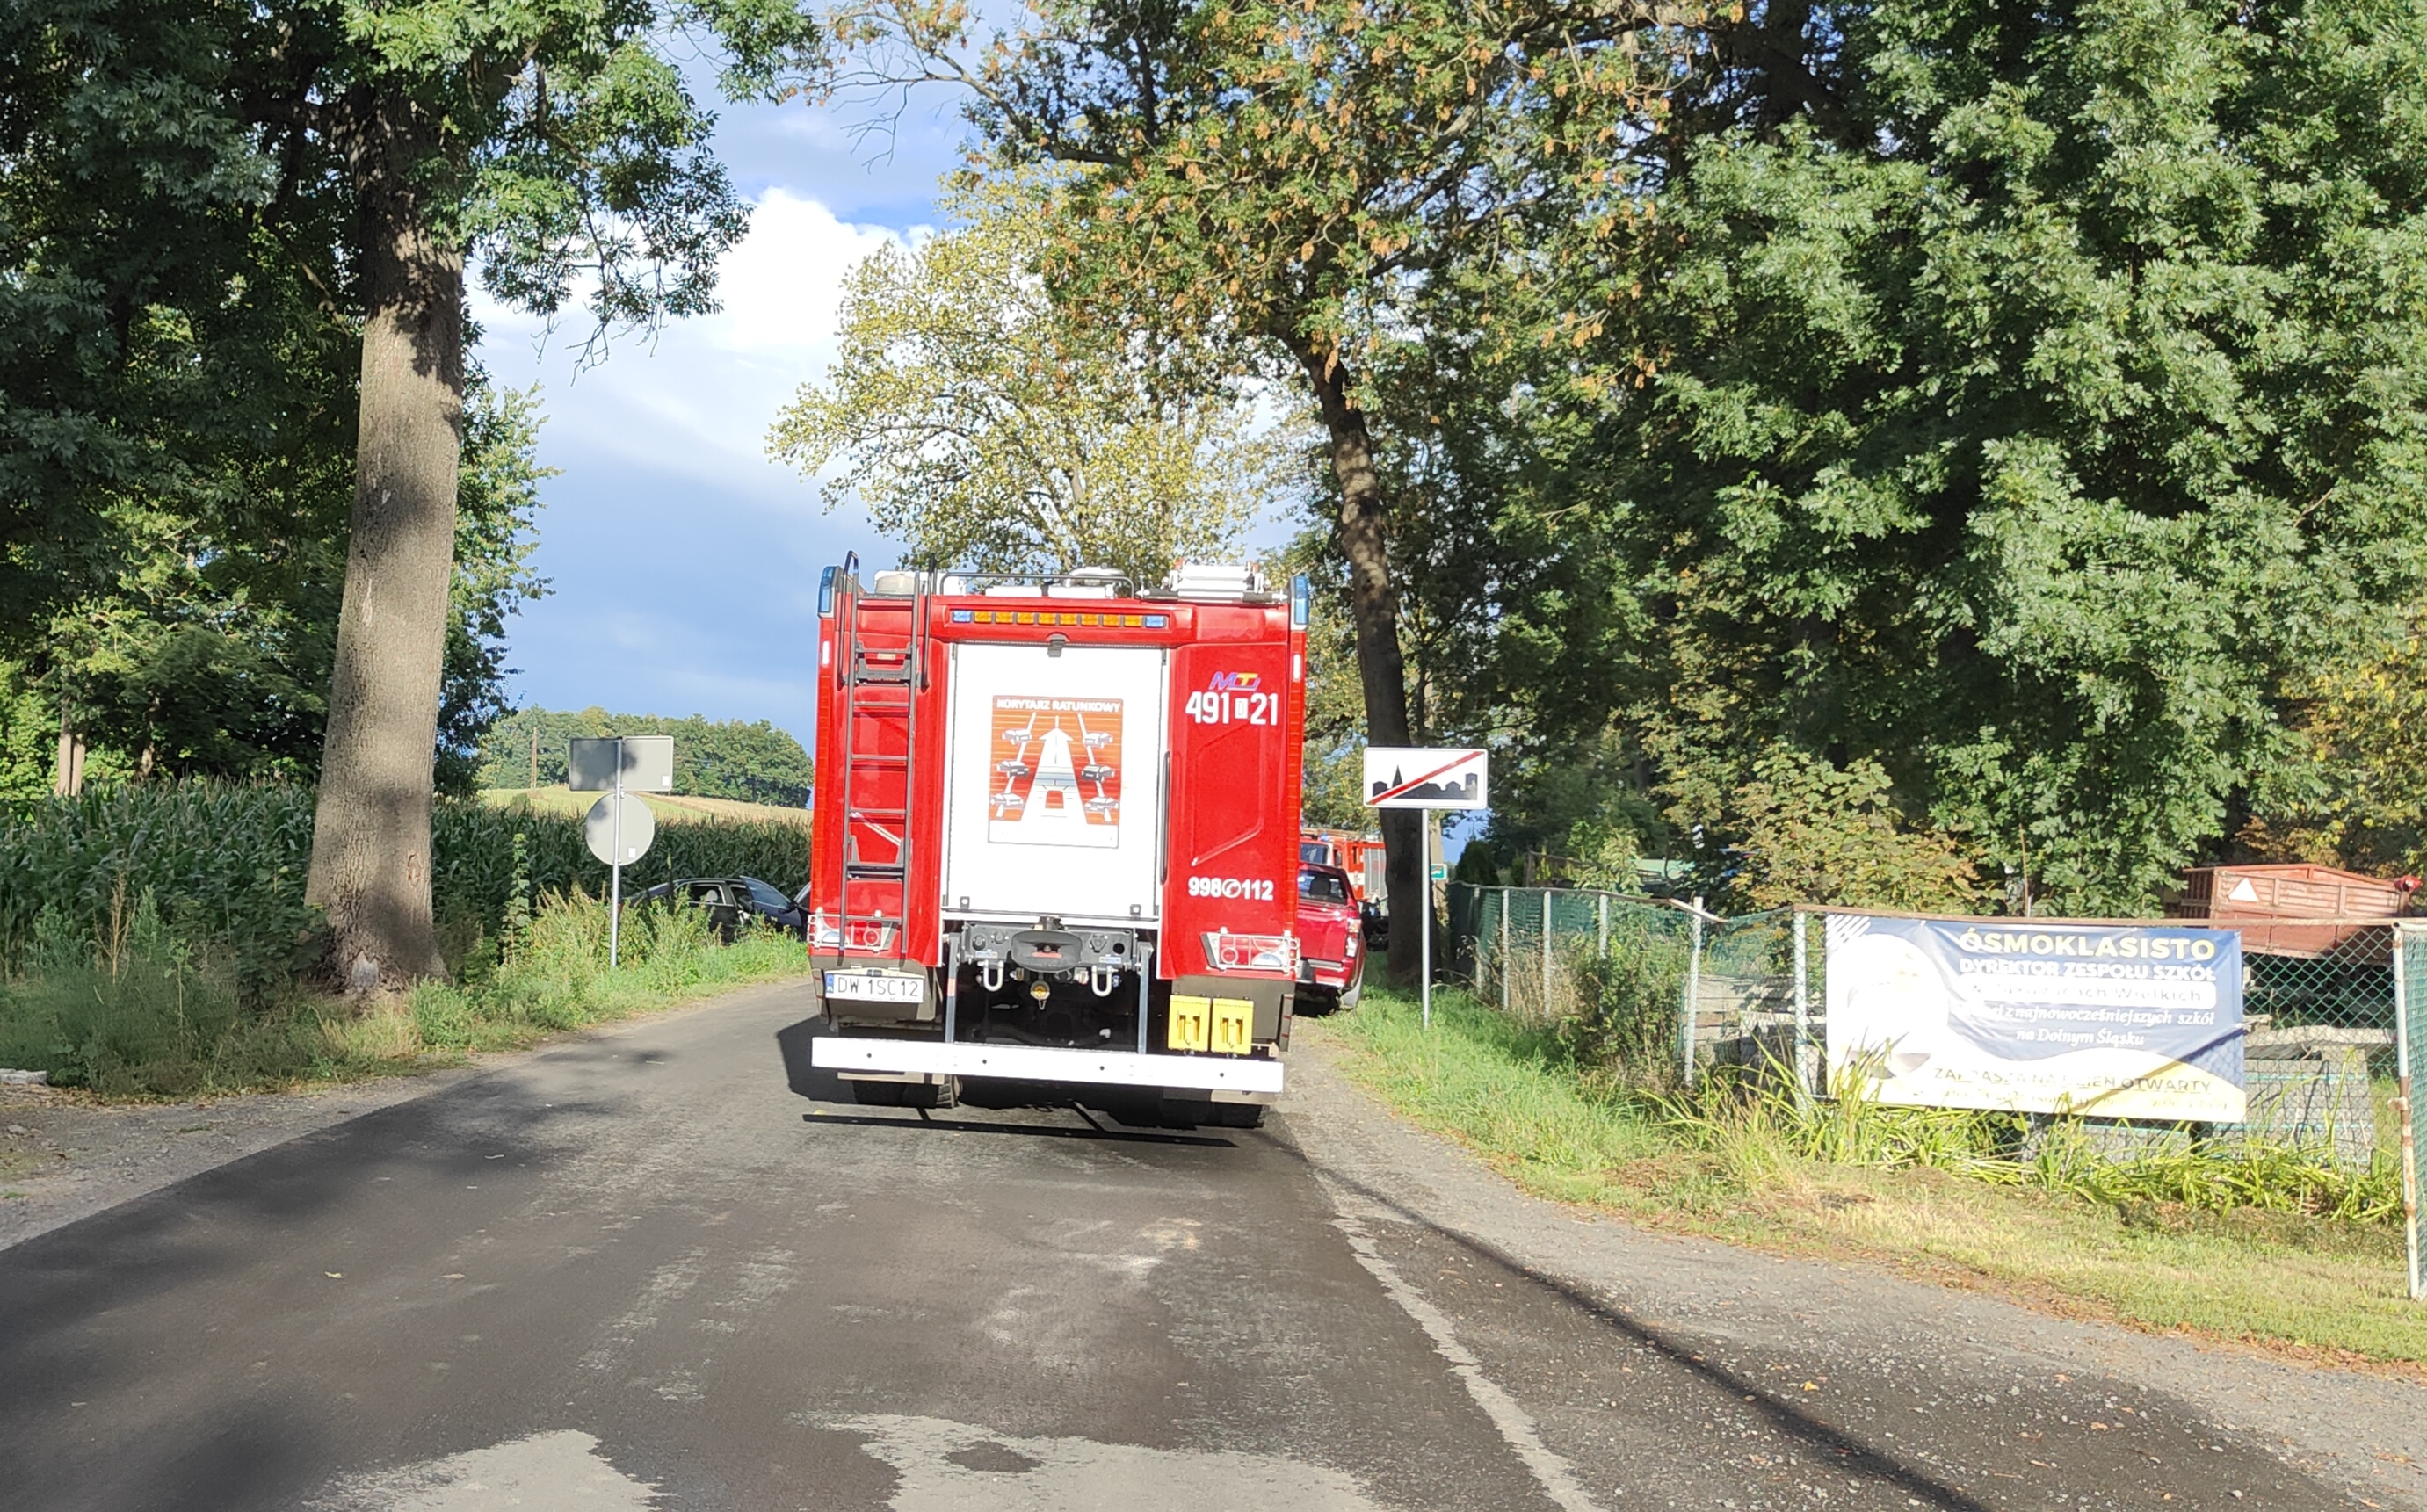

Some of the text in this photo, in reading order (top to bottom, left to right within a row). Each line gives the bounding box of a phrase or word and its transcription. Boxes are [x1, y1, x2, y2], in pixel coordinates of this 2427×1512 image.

[997, 698, 1120, 713] KORYTARZ RATUNKOWY
[1185, 691, 1229, 725] 491
[1250, 693, 1279, 726] 21
[1188, 876, 1274, 901] 998 112
[1959, 927, 2215, 961] ÓSMOKLASISTO
[1960, 958, 2217, 982] DYREKTOR ZESPOŁU SZKÓŁ
[837, 977, 918, 997] DW 1SC12
[2015, 1005, 2172, 1027] najnowocześniejszych
[2177, 1011, 2215, 1026] szkół
[2016, 1027, 2145, 1047] na Dolnym Śląsku
[2122, 1077, 2212, 1091] OTWARTY
